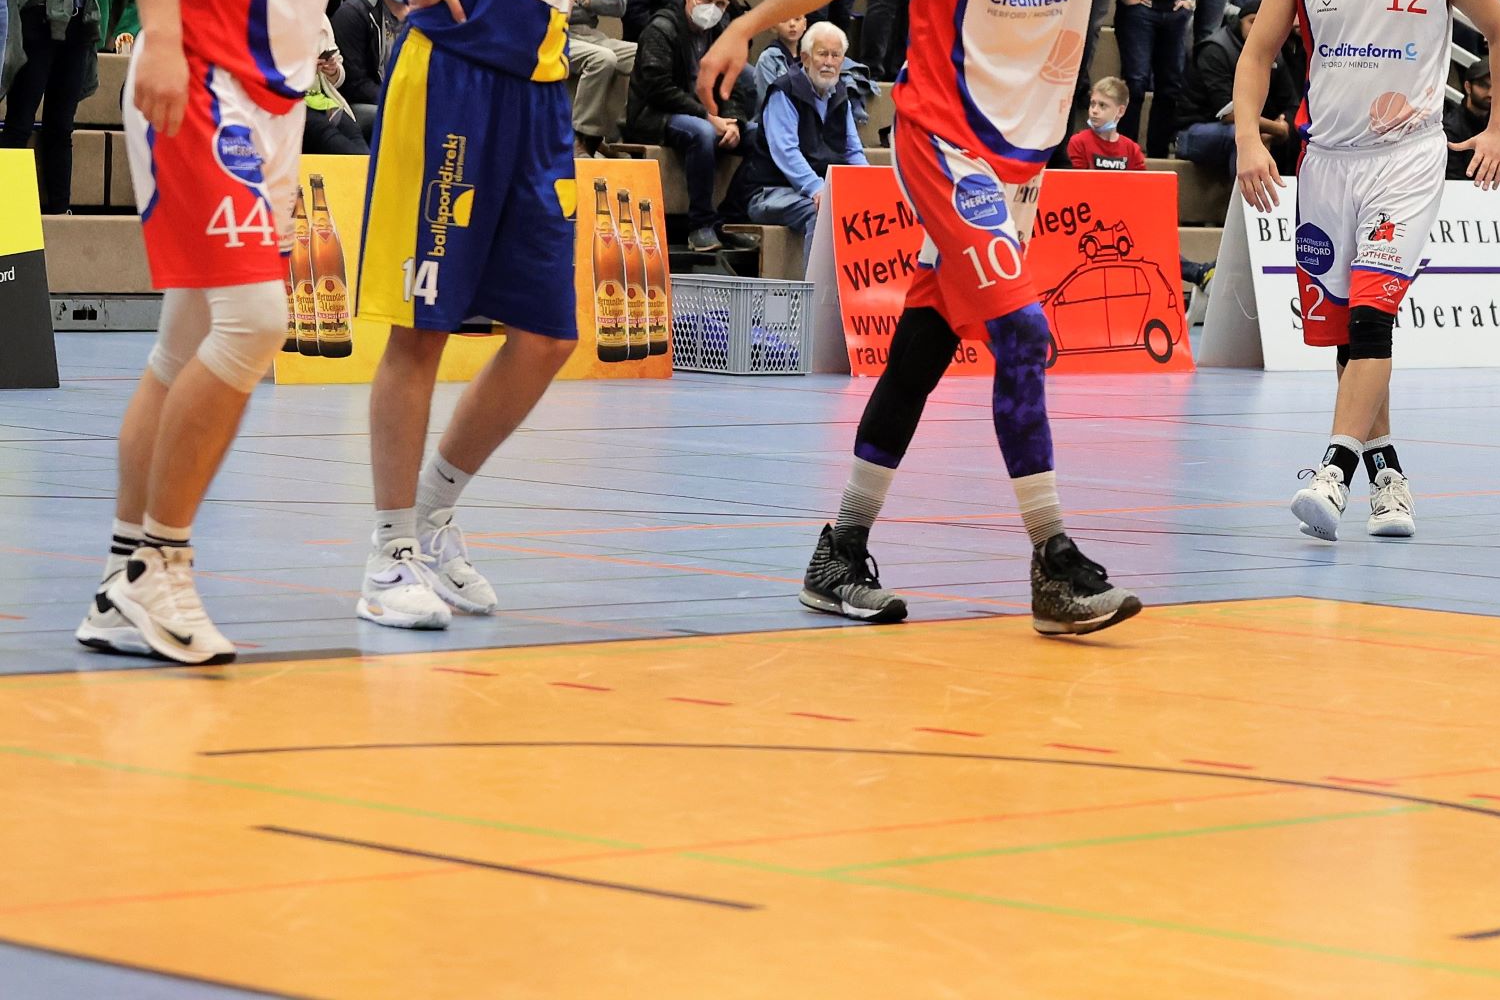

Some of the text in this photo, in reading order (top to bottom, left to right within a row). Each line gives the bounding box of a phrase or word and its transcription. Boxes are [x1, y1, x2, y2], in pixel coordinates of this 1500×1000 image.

[1318, 43, 1402, 60] Crditreform
[206, 195, 276, 247] 44
[842, 201, 919, 245] Kfz-M
[1256, 218, 1292, 242] BE
[962, 236, 1022, 289] 10
[1296, 244, 1332, 256] HERFORD
[402, 256, 440, 306] 14
